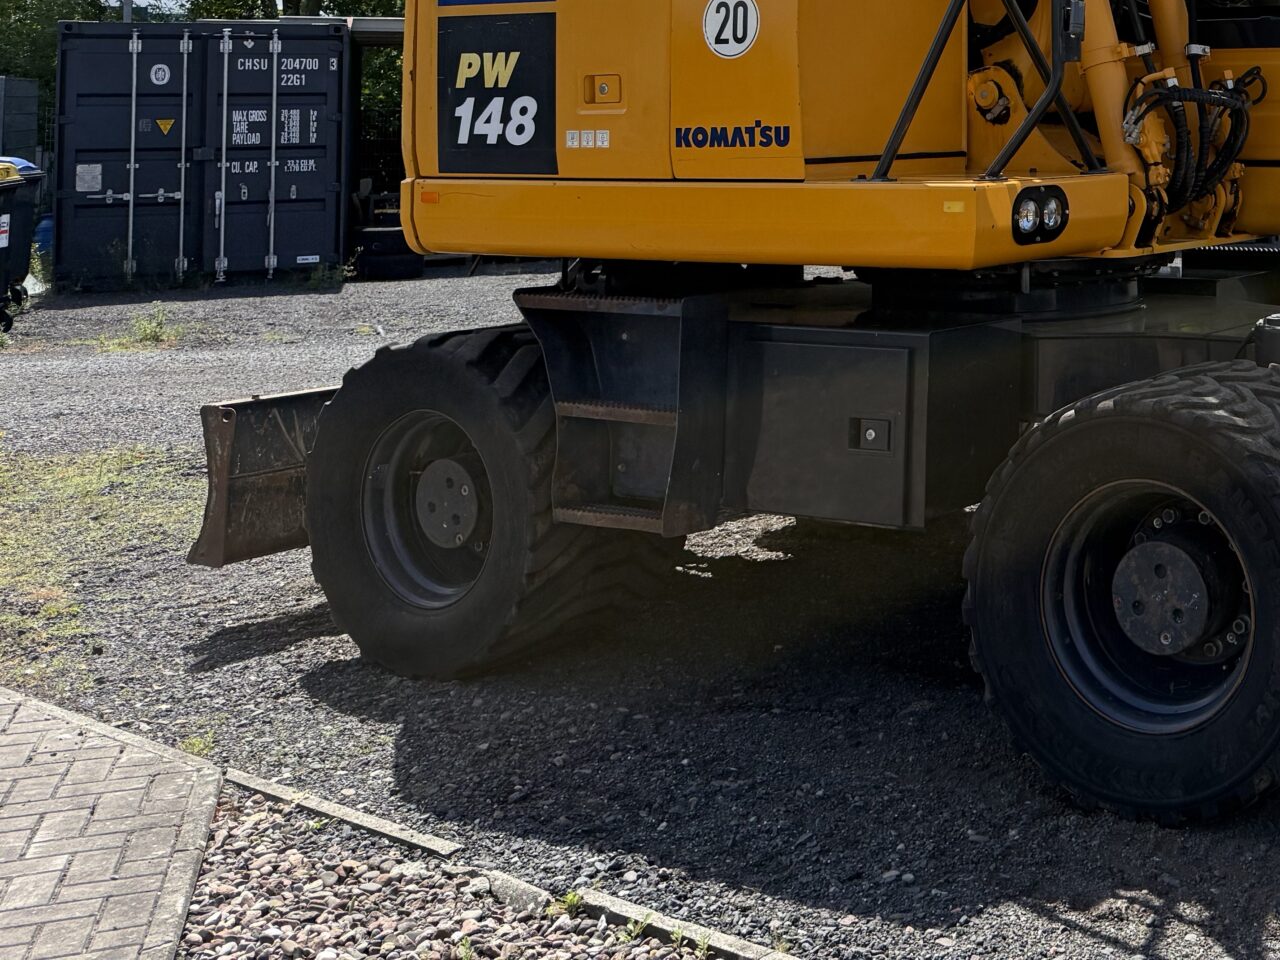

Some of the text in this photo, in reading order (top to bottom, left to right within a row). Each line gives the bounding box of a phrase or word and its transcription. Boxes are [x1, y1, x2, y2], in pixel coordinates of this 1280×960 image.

[714, 0, 749, 46] 20
[237, 58, 338, 70] CHSU 204700 3
[455, 51, 520, 89] PW
[280, 74, 306, 86] 22G1
[232, 110, 267, 122] MAX GROSS
[453, 95, 538, 146] 148
[233, 121, 248, 133] TARE
[232, 132, 261, 145] PAYLOAD
[675, 119, 791, 149] KOMATSU
[231, 161, 259, 173] CU. CAP.
